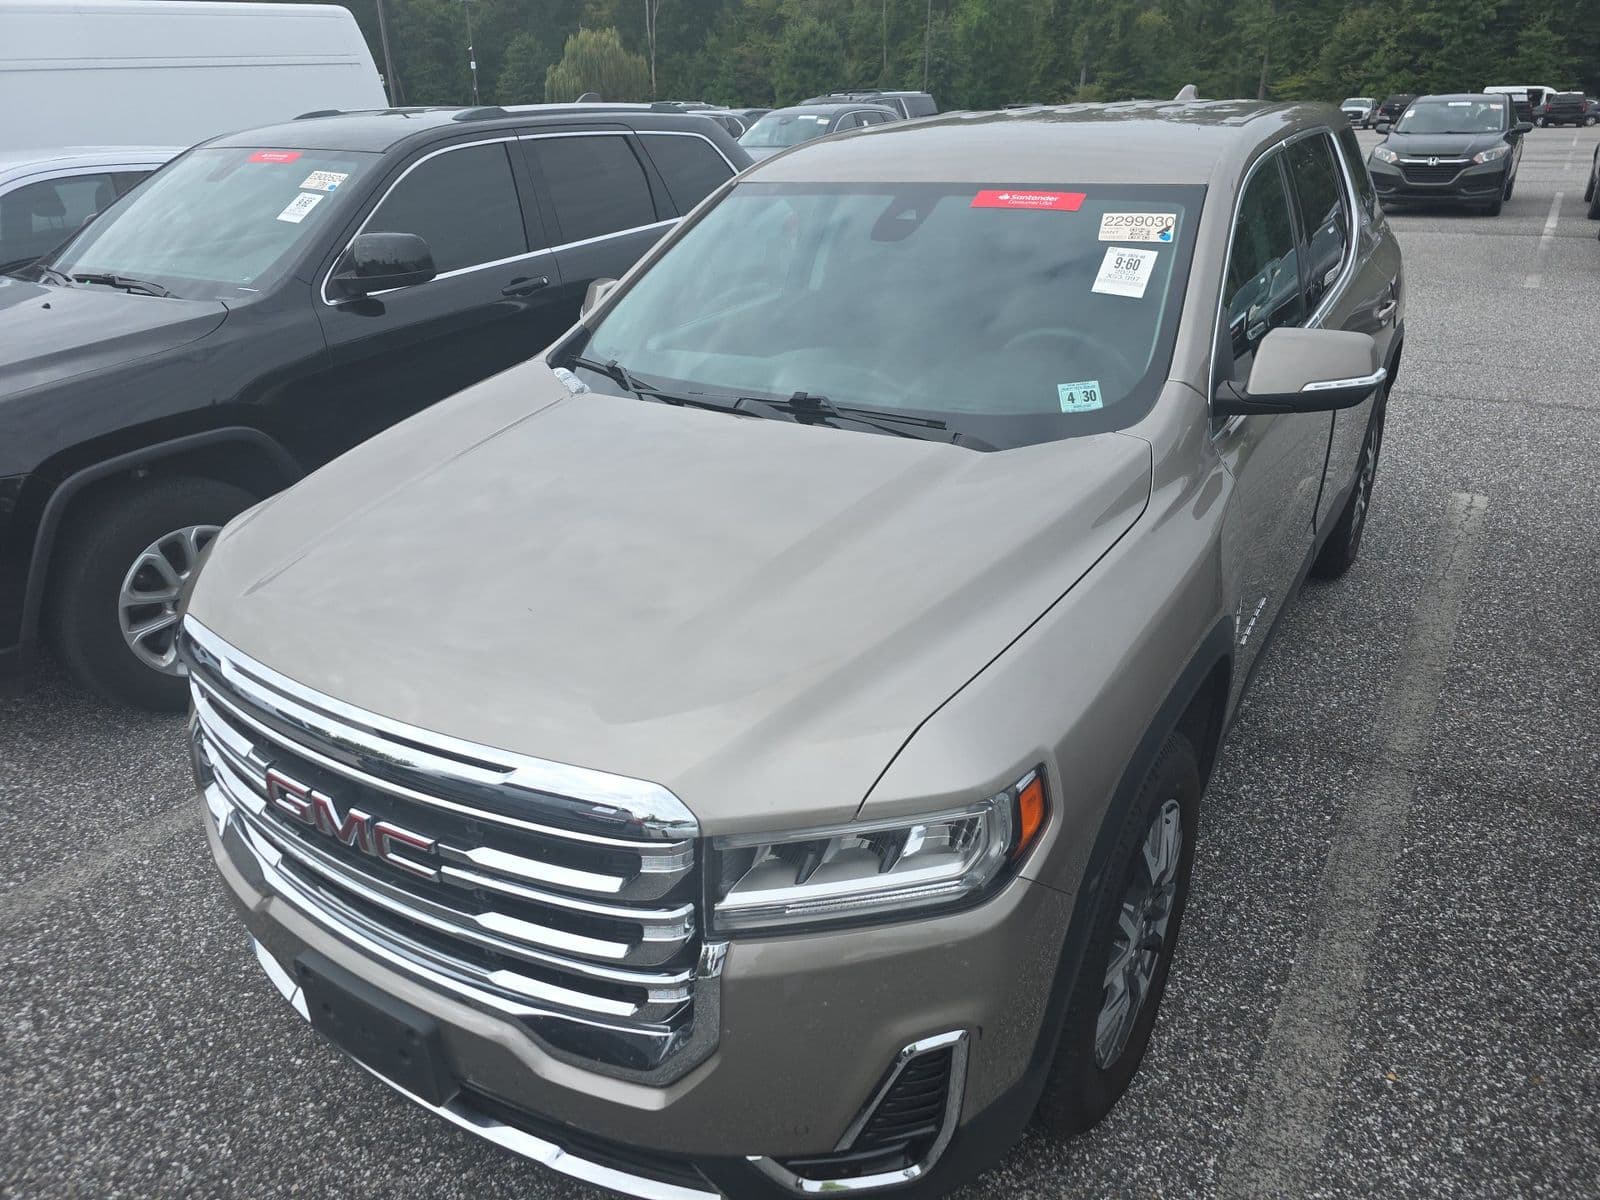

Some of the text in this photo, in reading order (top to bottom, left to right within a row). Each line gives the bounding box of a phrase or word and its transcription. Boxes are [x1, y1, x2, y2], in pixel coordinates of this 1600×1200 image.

[1010, 193, 1058, 202] Santander
[1104, 215, 1175, 228] 2299030
[1114, 256, 1141, 271] 9:60
[1067, 390, 1097, 403] 4 30
[265, 767, 442, 883] GMC
